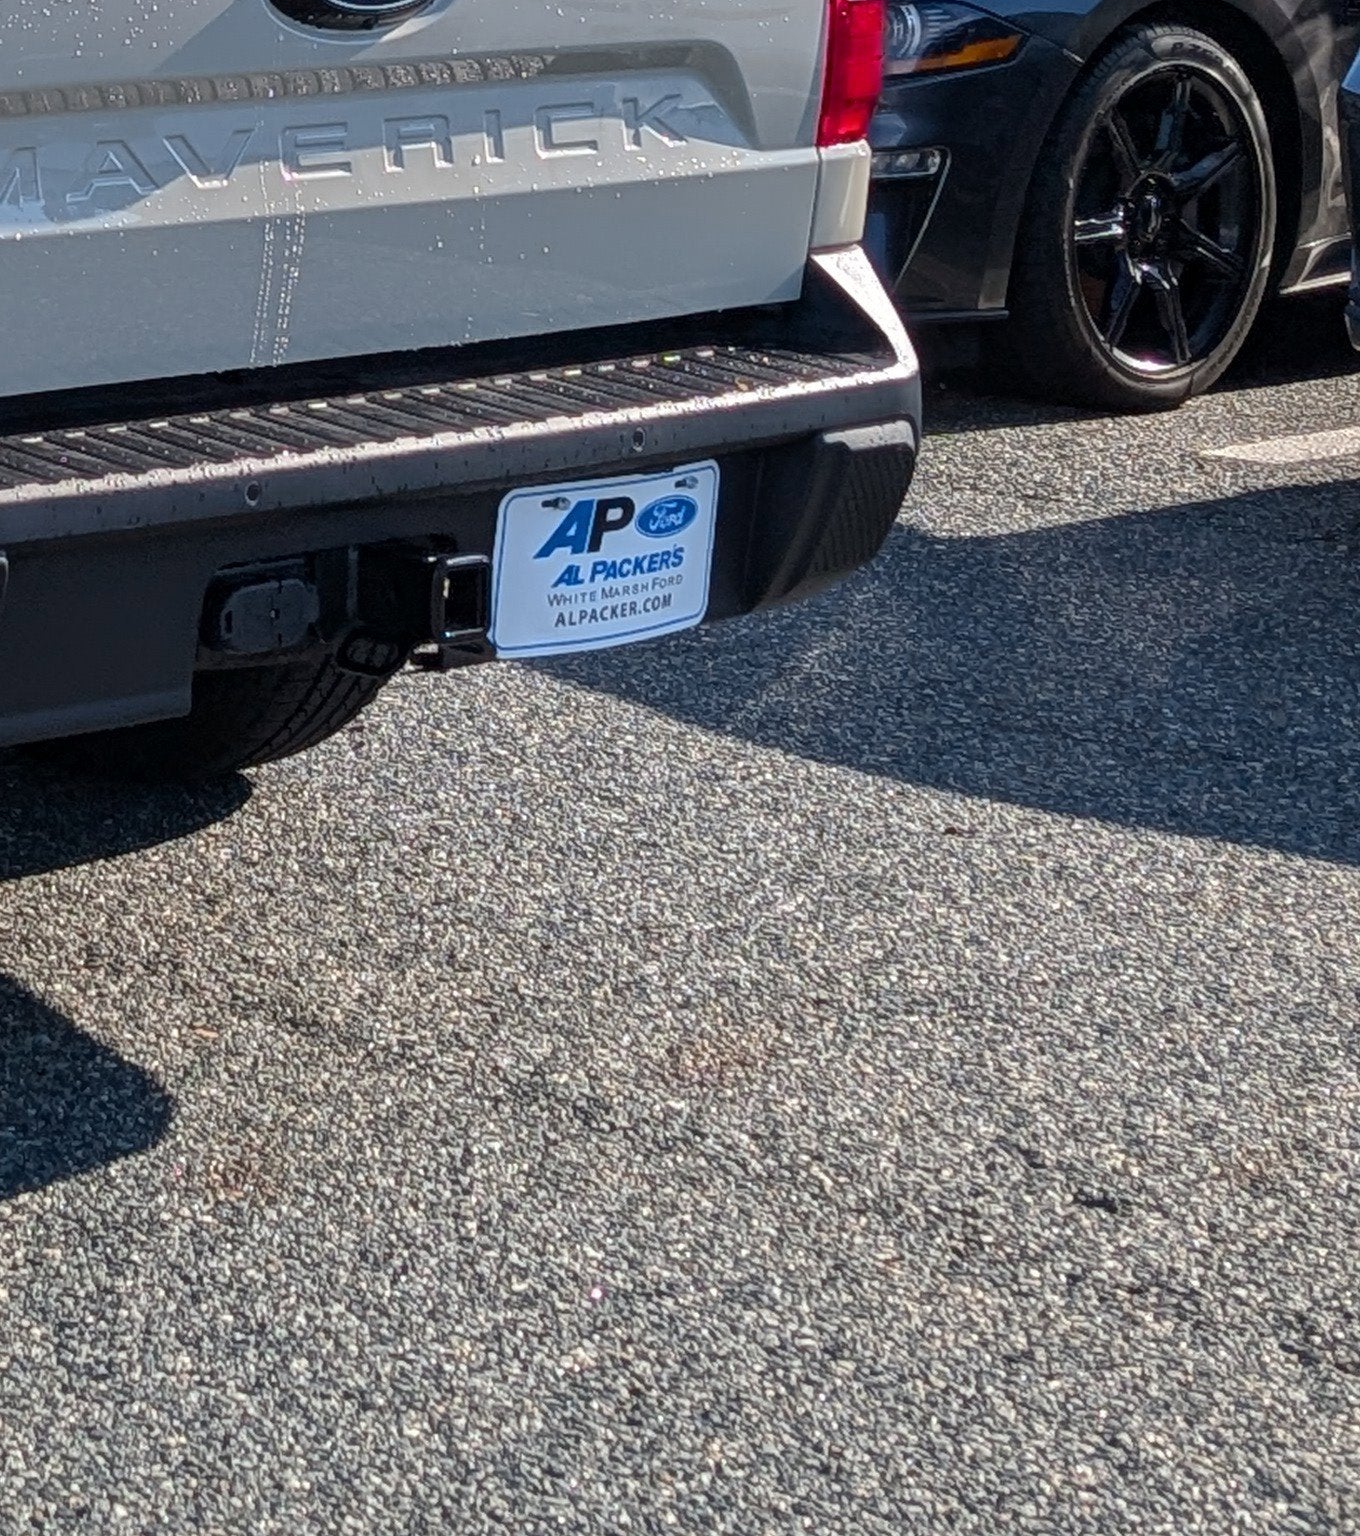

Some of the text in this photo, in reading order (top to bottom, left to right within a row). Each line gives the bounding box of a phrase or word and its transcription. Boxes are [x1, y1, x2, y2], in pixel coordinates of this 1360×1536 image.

[533, 496, 686, 560] AP Ford
[551, 544, 686, 589] AL PACKER'S
[547, 573, 684, 608] WHITE MARSH FORD
[554, 592, 673, 628] ALPACKER.COM
